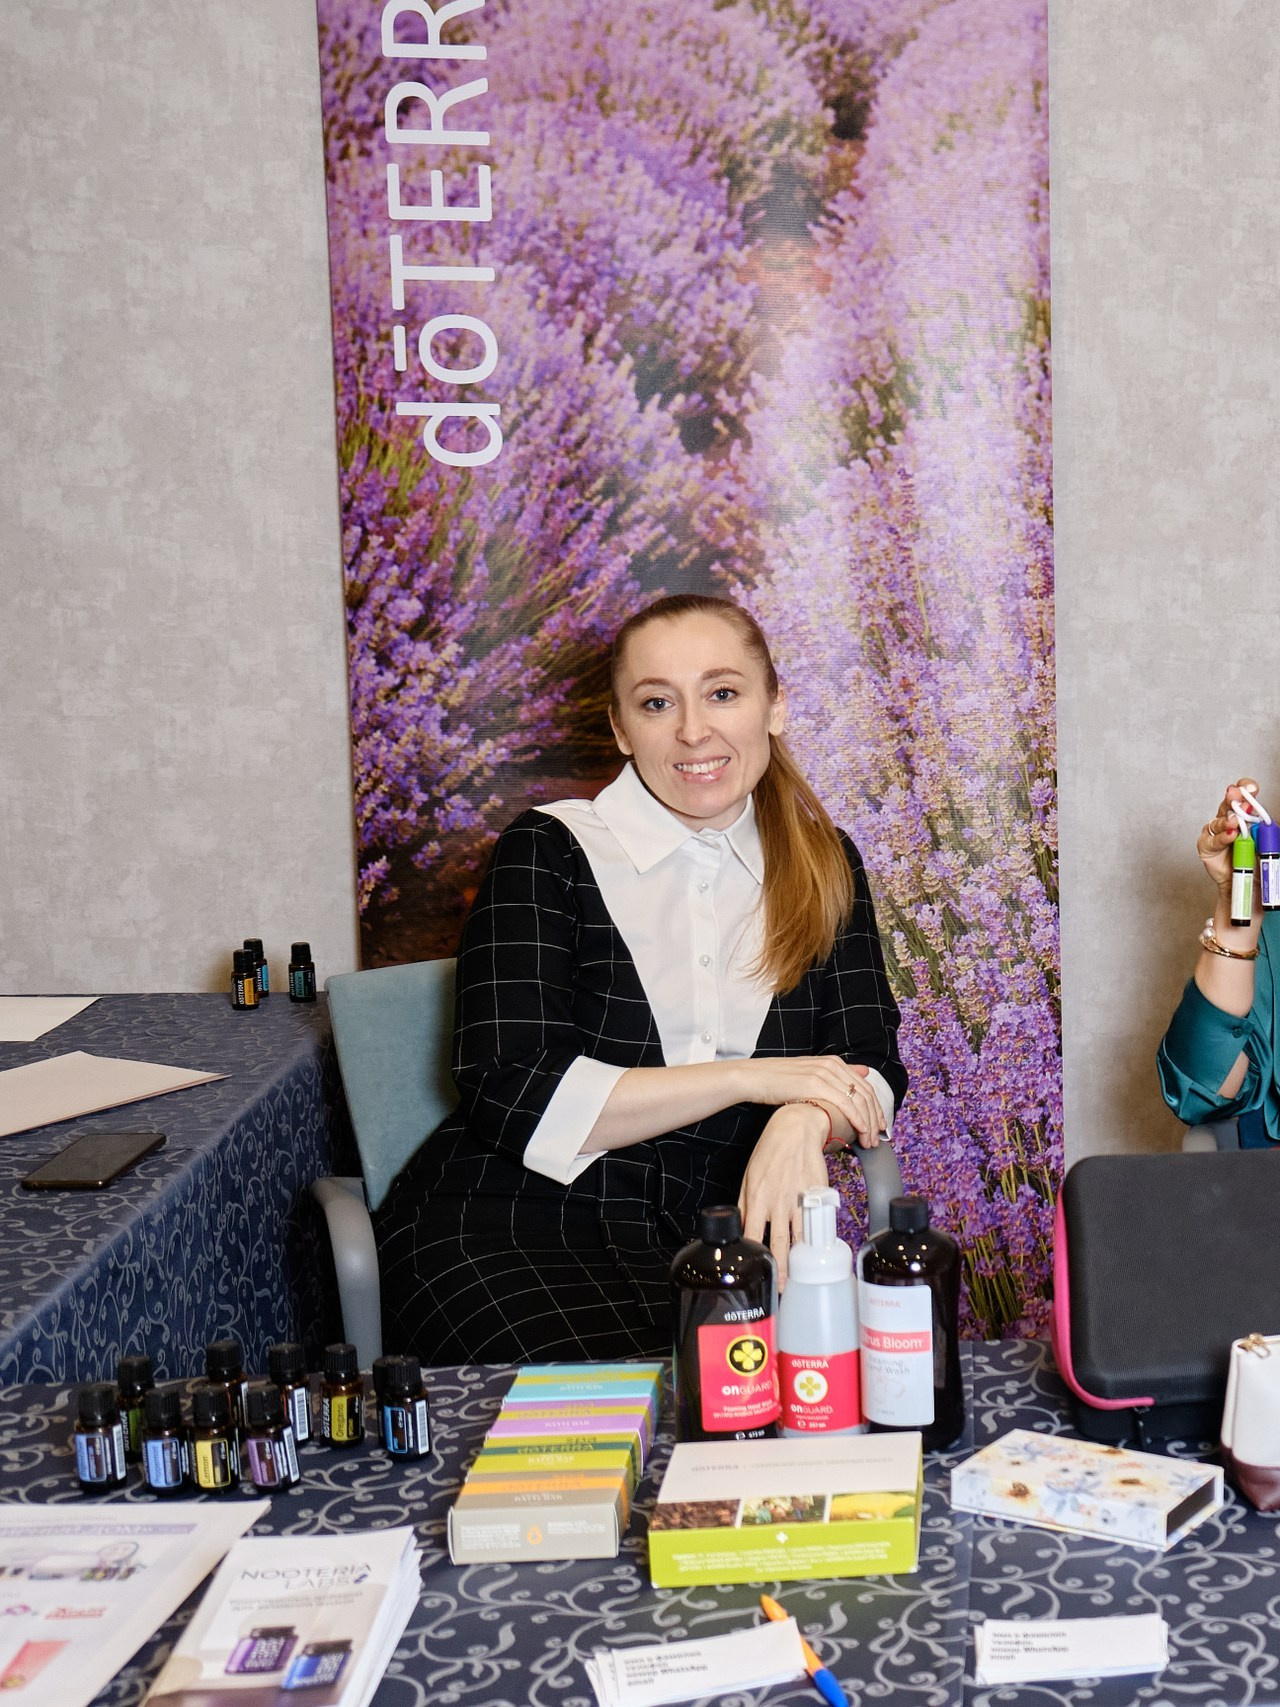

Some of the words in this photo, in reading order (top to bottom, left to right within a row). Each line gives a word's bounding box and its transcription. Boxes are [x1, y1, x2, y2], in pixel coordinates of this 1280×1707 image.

[883, 1336, 922, 1349] Bloom
[201, 1456, 211, 1484] Lemon
[241, 1563, 372, 1581] NOOTERIA
[285, 1577, 350, 1590] LABS
